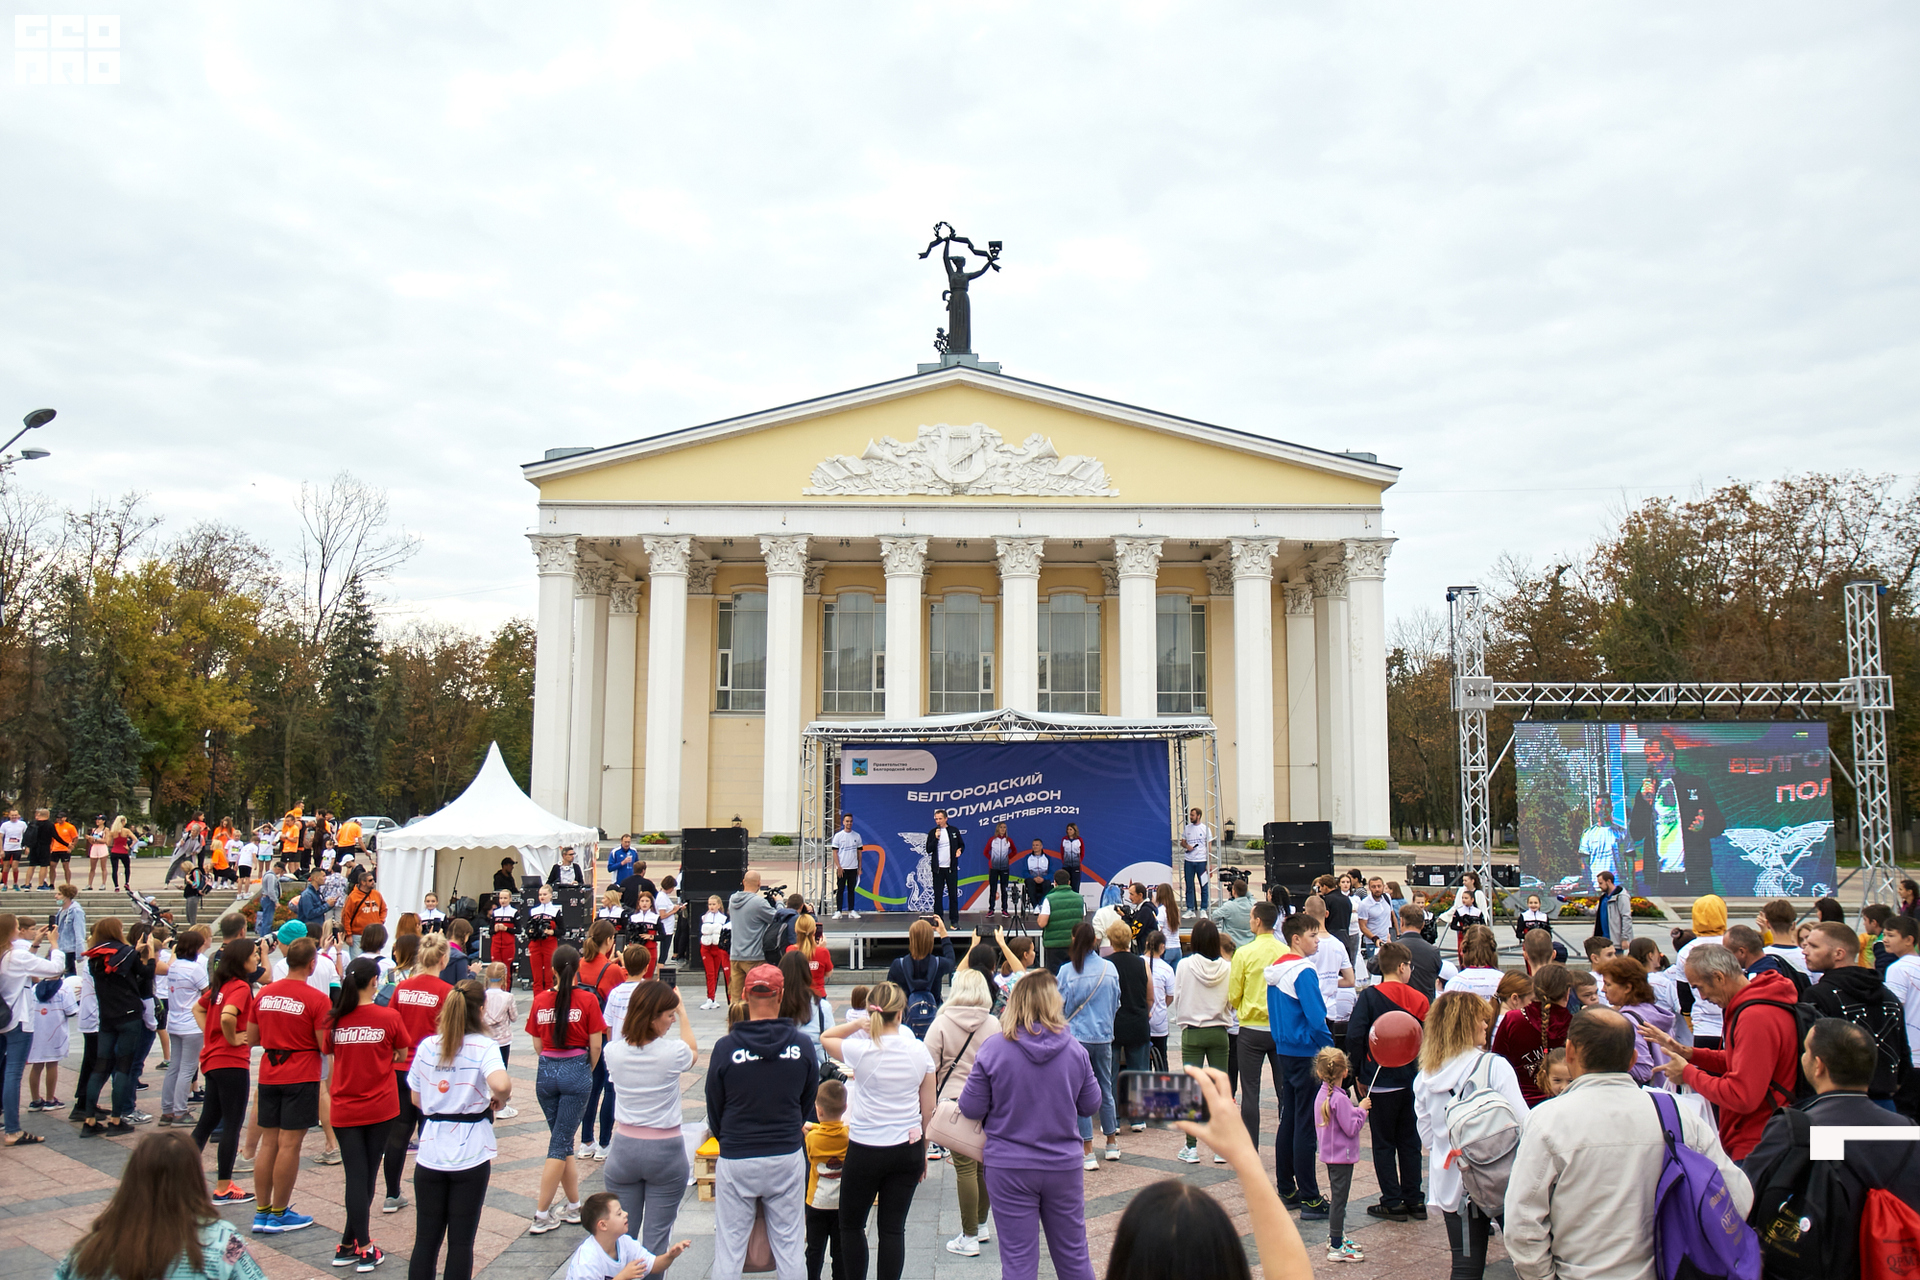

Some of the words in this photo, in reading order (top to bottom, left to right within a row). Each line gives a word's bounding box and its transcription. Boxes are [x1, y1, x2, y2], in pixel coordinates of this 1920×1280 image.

[907, 771, 1043, 802] БЕЛГОРОДСКИЙ
[978, 818, 989, 827] 12
[991, 806, 1052, 824] СЕНТЯБРЯ
[1054, 805, 1080, 815] 2021
[260, 997, 283, 1010] World
[281, 998, 303, 1013] Class
[399, 990, 419, 1003] World
[417, 992, 438, 1006] Class
[358, 1028, 383, 1042] Class
